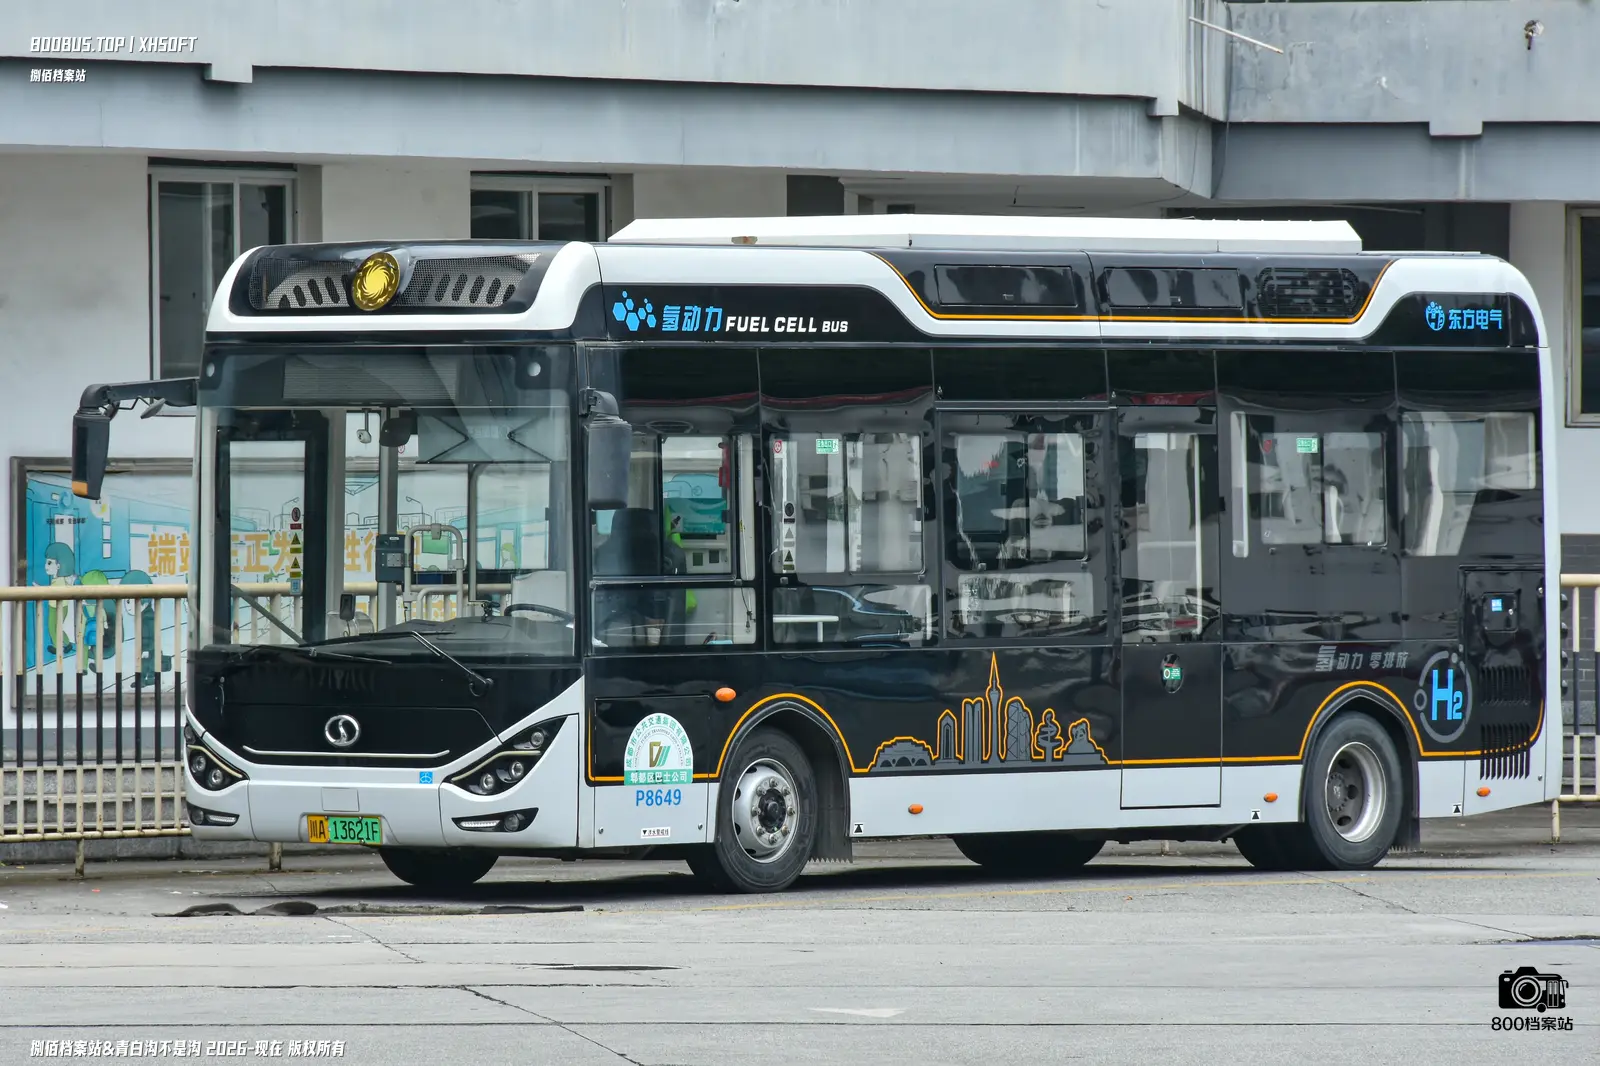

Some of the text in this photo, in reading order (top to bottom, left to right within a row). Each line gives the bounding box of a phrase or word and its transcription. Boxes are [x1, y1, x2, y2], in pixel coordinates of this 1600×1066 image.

[661, 304, 849, 333] 氢动力 FUEL CELL BUS
[1448, 308, 1503, 330] 东方电气
[1431, 668, 1464, 721] H2
[635, 788, 682, 807] P8649
